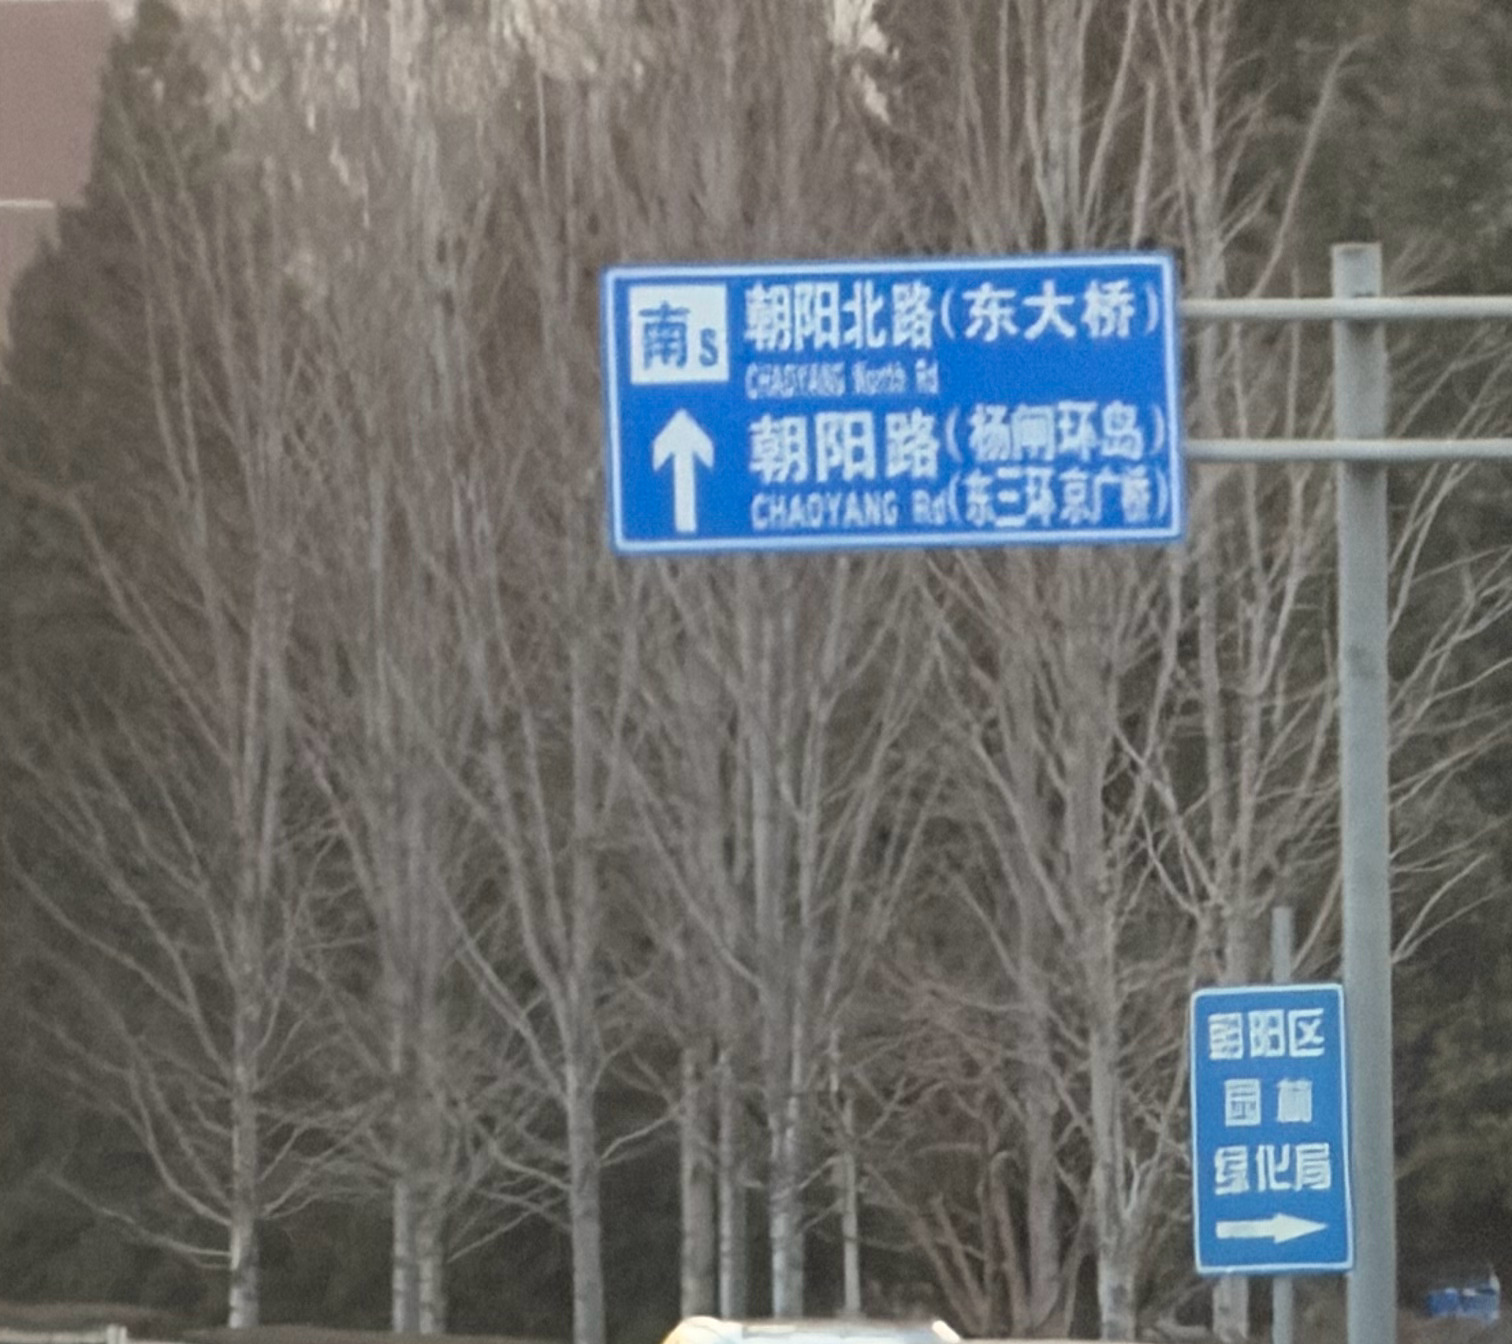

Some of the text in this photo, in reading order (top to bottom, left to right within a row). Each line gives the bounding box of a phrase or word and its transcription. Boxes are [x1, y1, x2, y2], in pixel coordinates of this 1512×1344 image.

[638, 303, 689, 370] 南
[699, 328, 718, 367] S
[749, 408, 940, 483] 朝阳路
[751, 491, 898, 530] CHAOYANG
